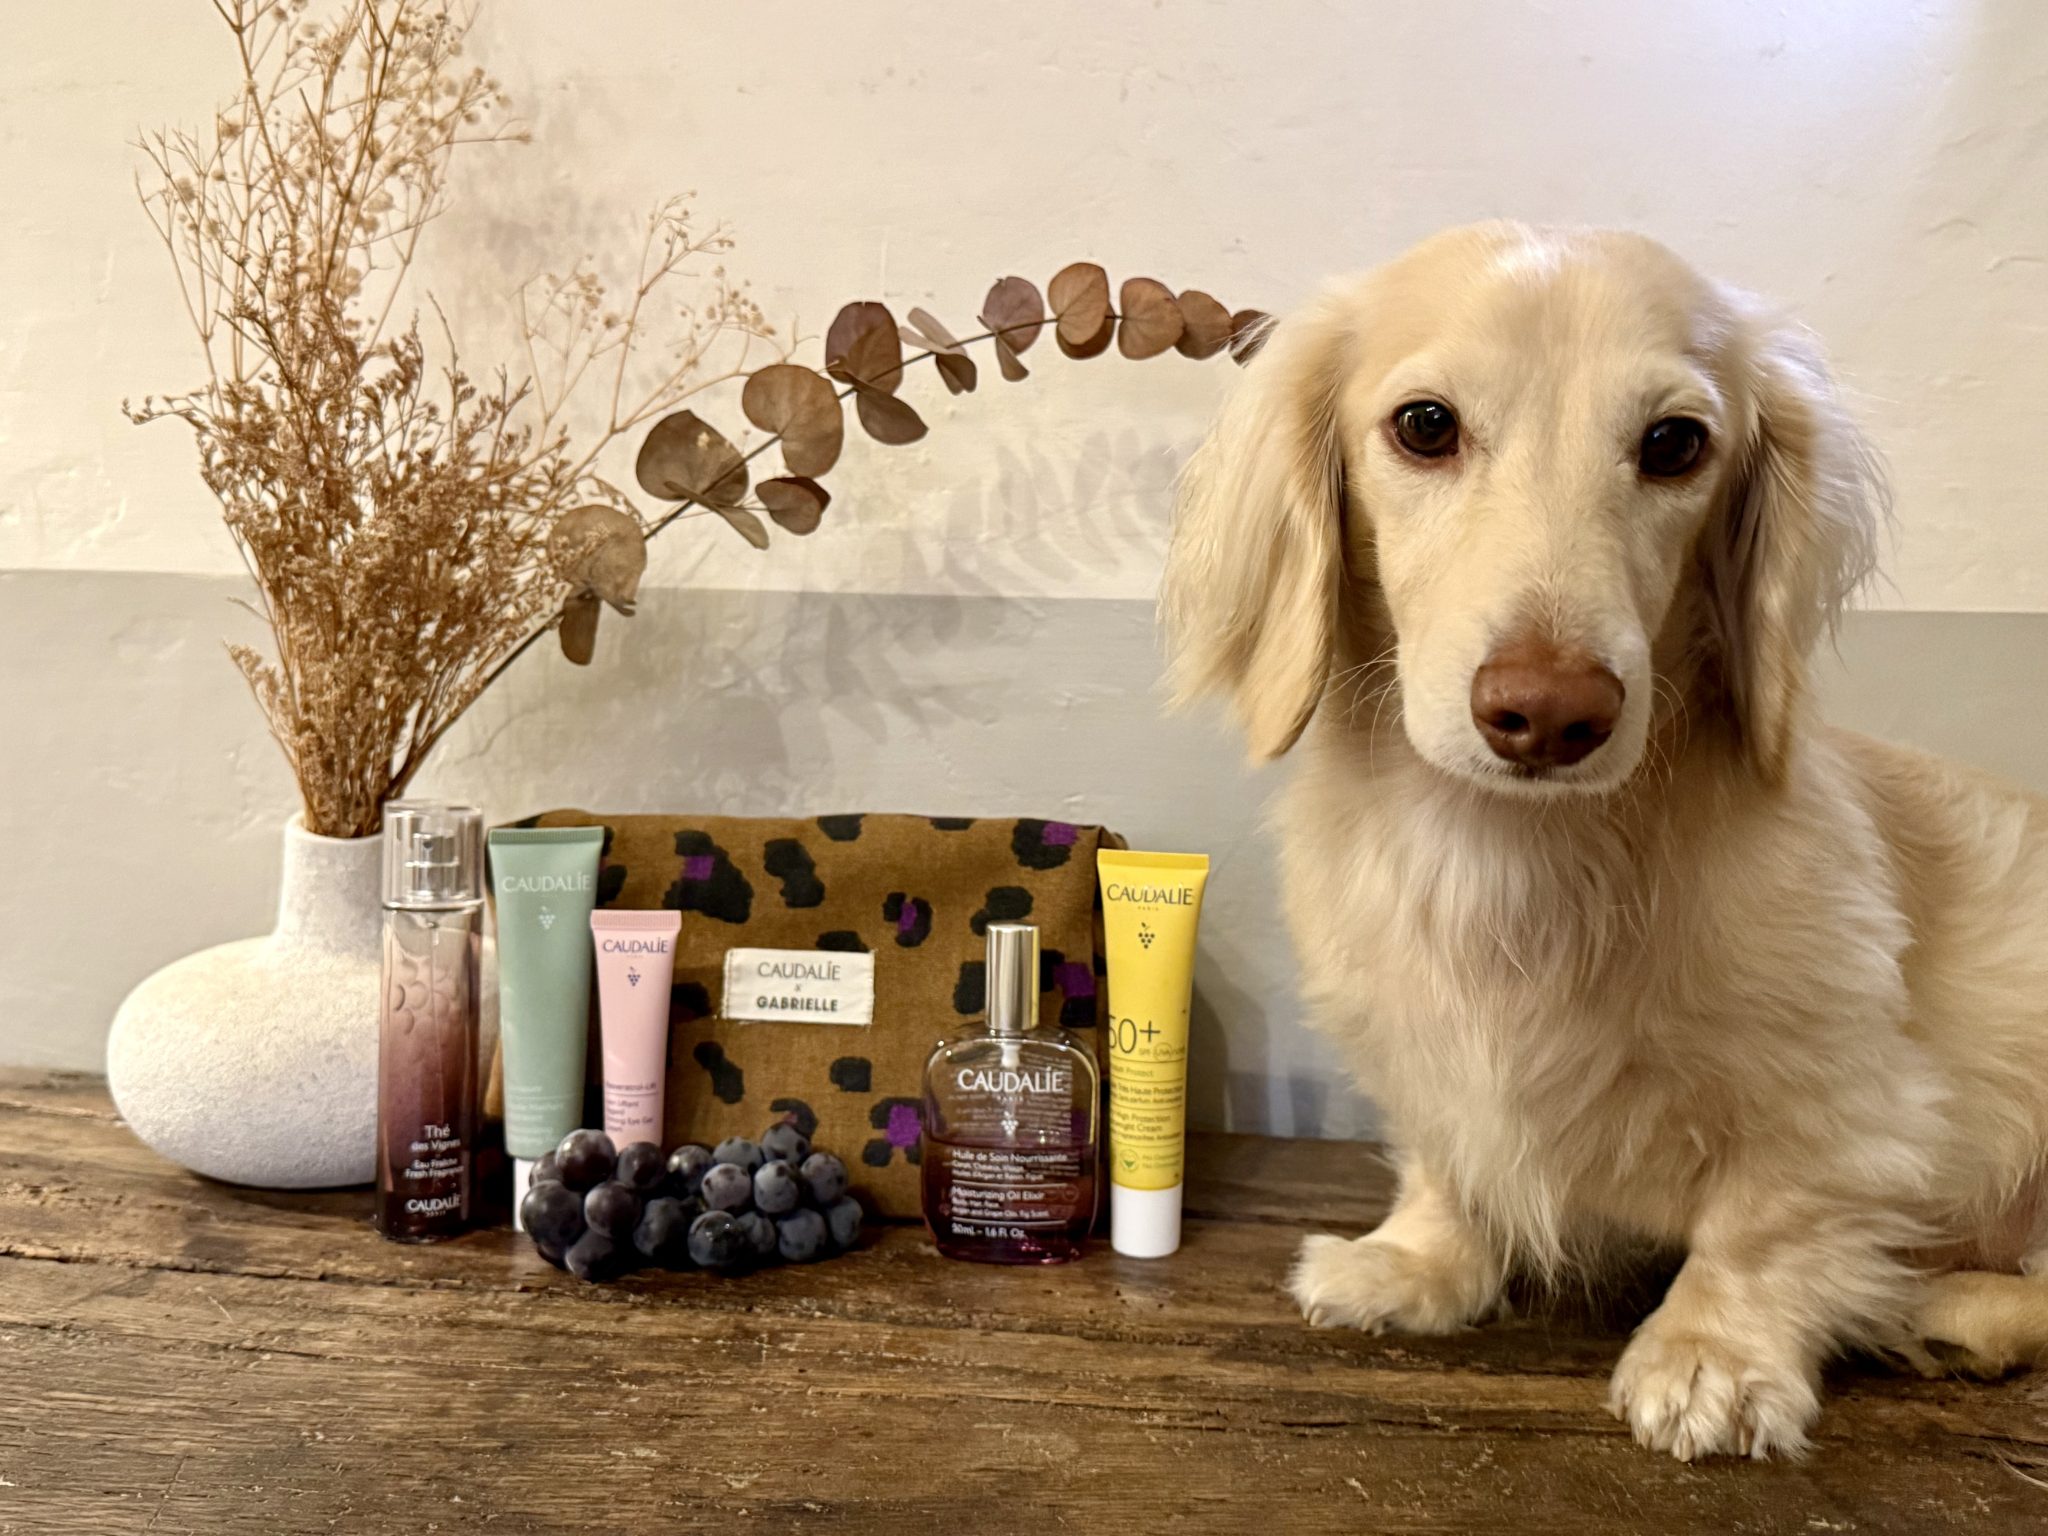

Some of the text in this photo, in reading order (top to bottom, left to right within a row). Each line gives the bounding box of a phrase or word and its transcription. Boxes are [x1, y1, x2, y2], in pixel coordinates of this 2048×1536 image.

[757, 996, 839, 1012] GABRIELLE
[424, 1123, 450, 1139] Thé
[952, 1150, 975, 1160] Huile
[976, 1152, 988, 1161] de
[989, 1152, 1009, 1162] Soin
[951, 1186, 1045, 1201] Moisturizing Oil Elixir
